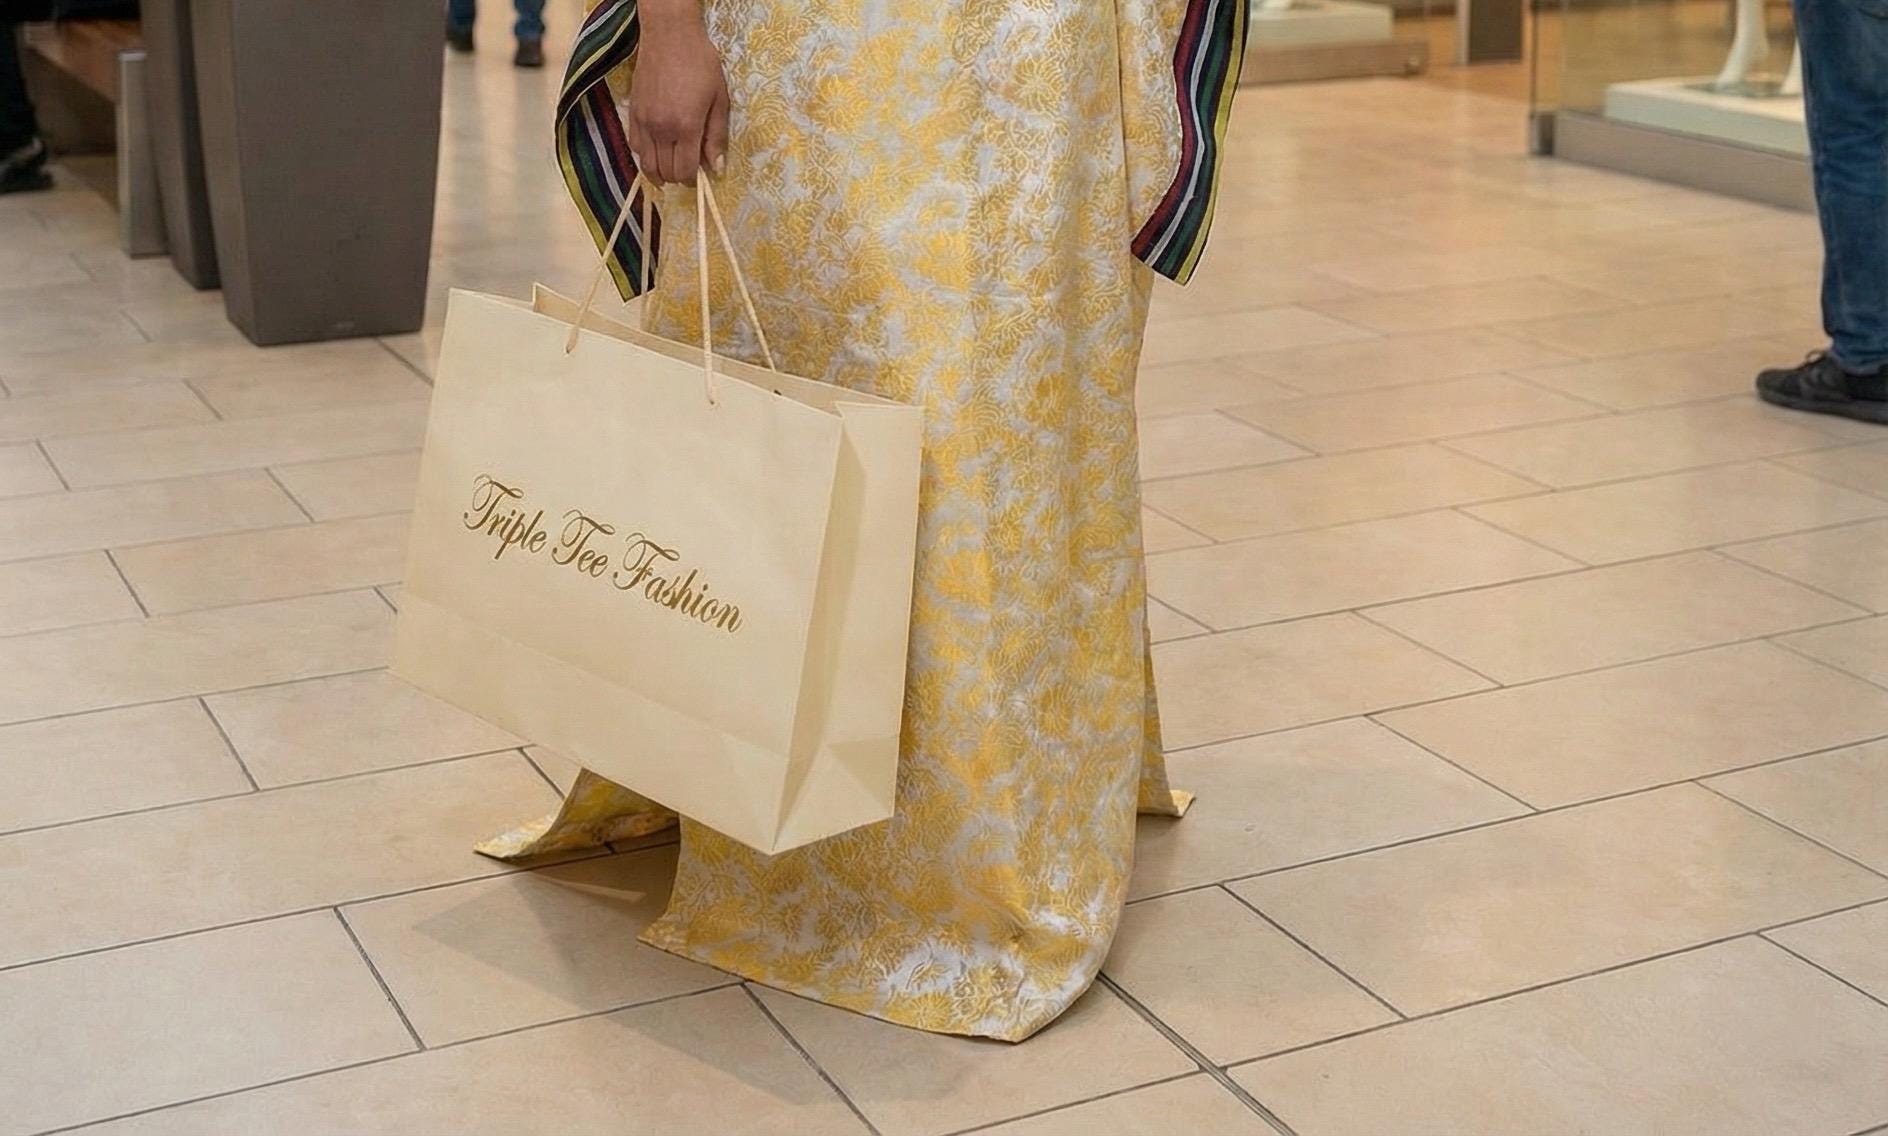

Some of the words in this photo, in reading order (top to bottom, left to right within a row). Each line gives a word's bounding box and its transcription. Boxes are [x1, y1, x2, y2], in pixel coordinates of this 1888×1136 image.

[463, 474, 547, 560] Triple
[551, 509, 615, 578] Tee
[613, 532, 743, 633] Fashion
